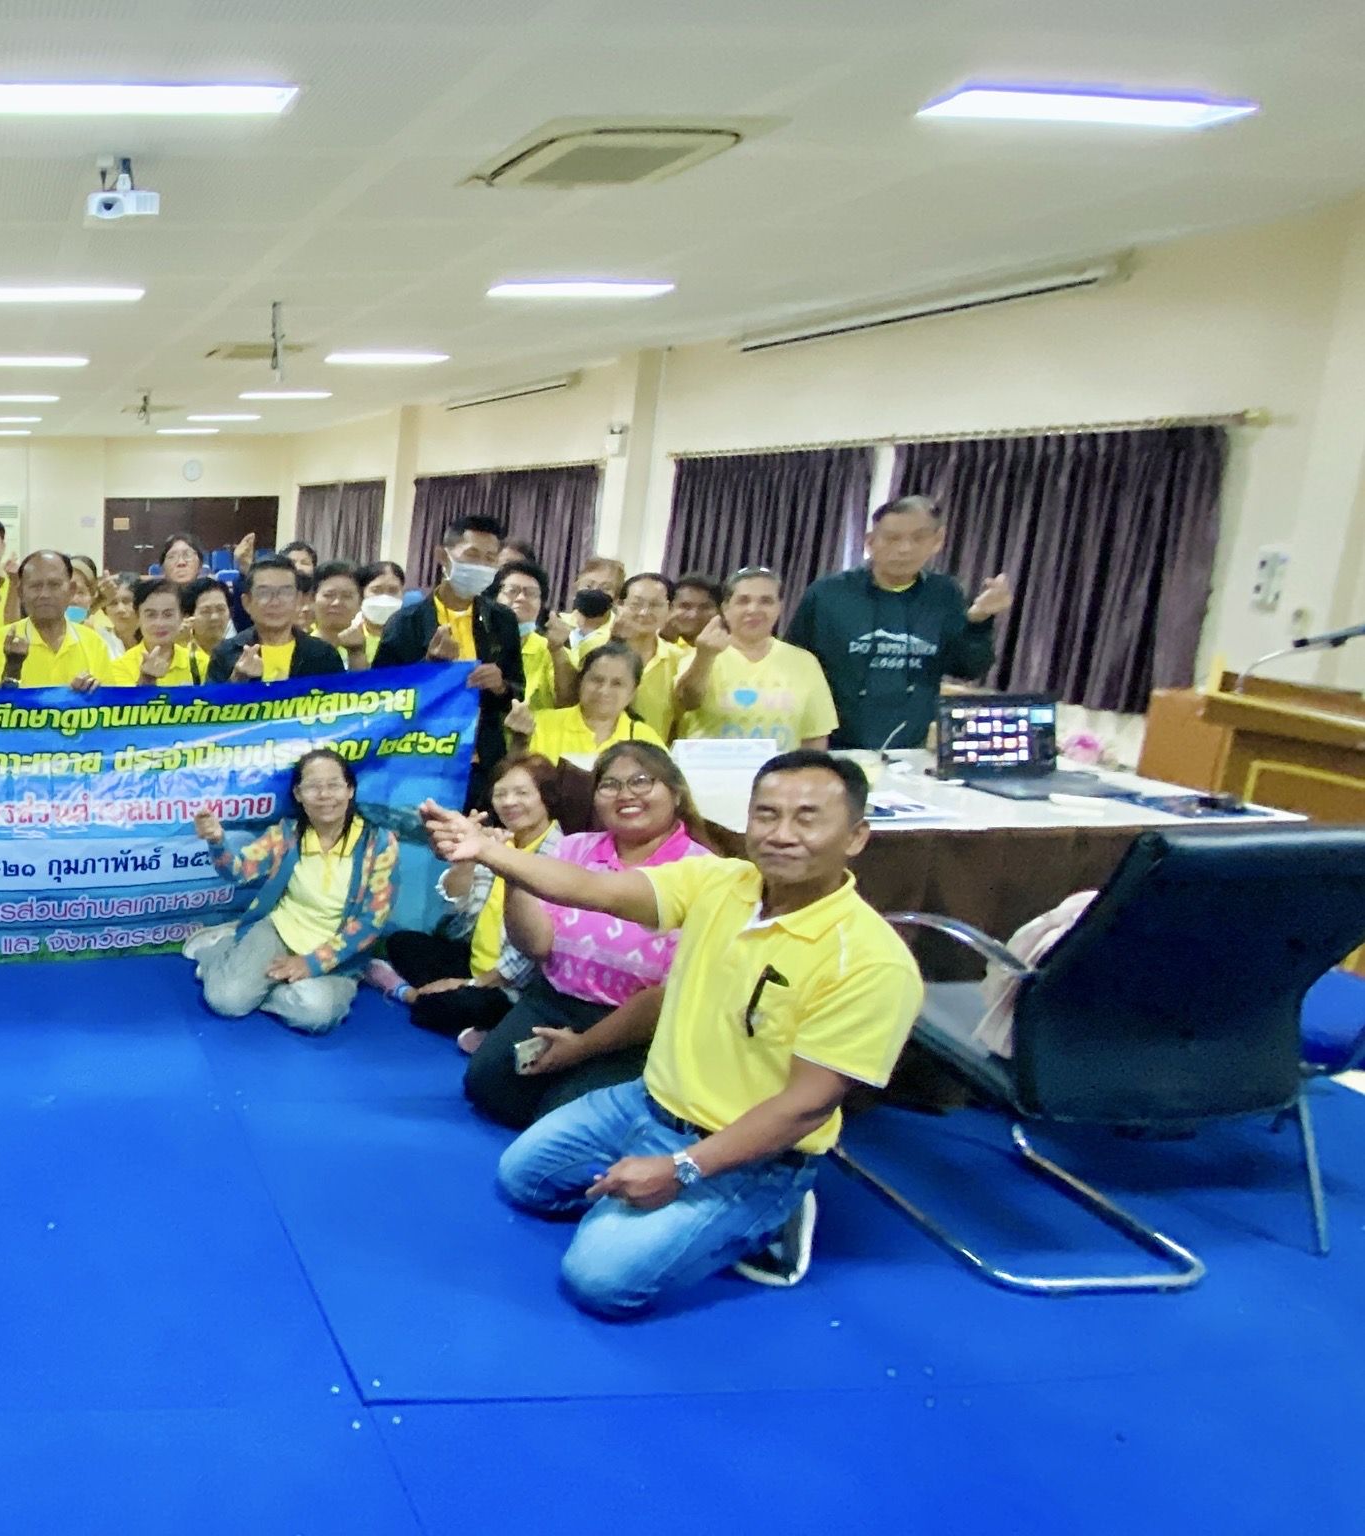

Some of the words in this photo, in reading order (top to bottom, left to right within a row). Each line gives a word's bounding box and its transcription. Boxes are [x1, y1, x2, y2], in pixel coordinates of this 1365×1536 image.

[48, 845, 163, 884] กุมภาพันธ์
[2, 935, 39, 954] และ
